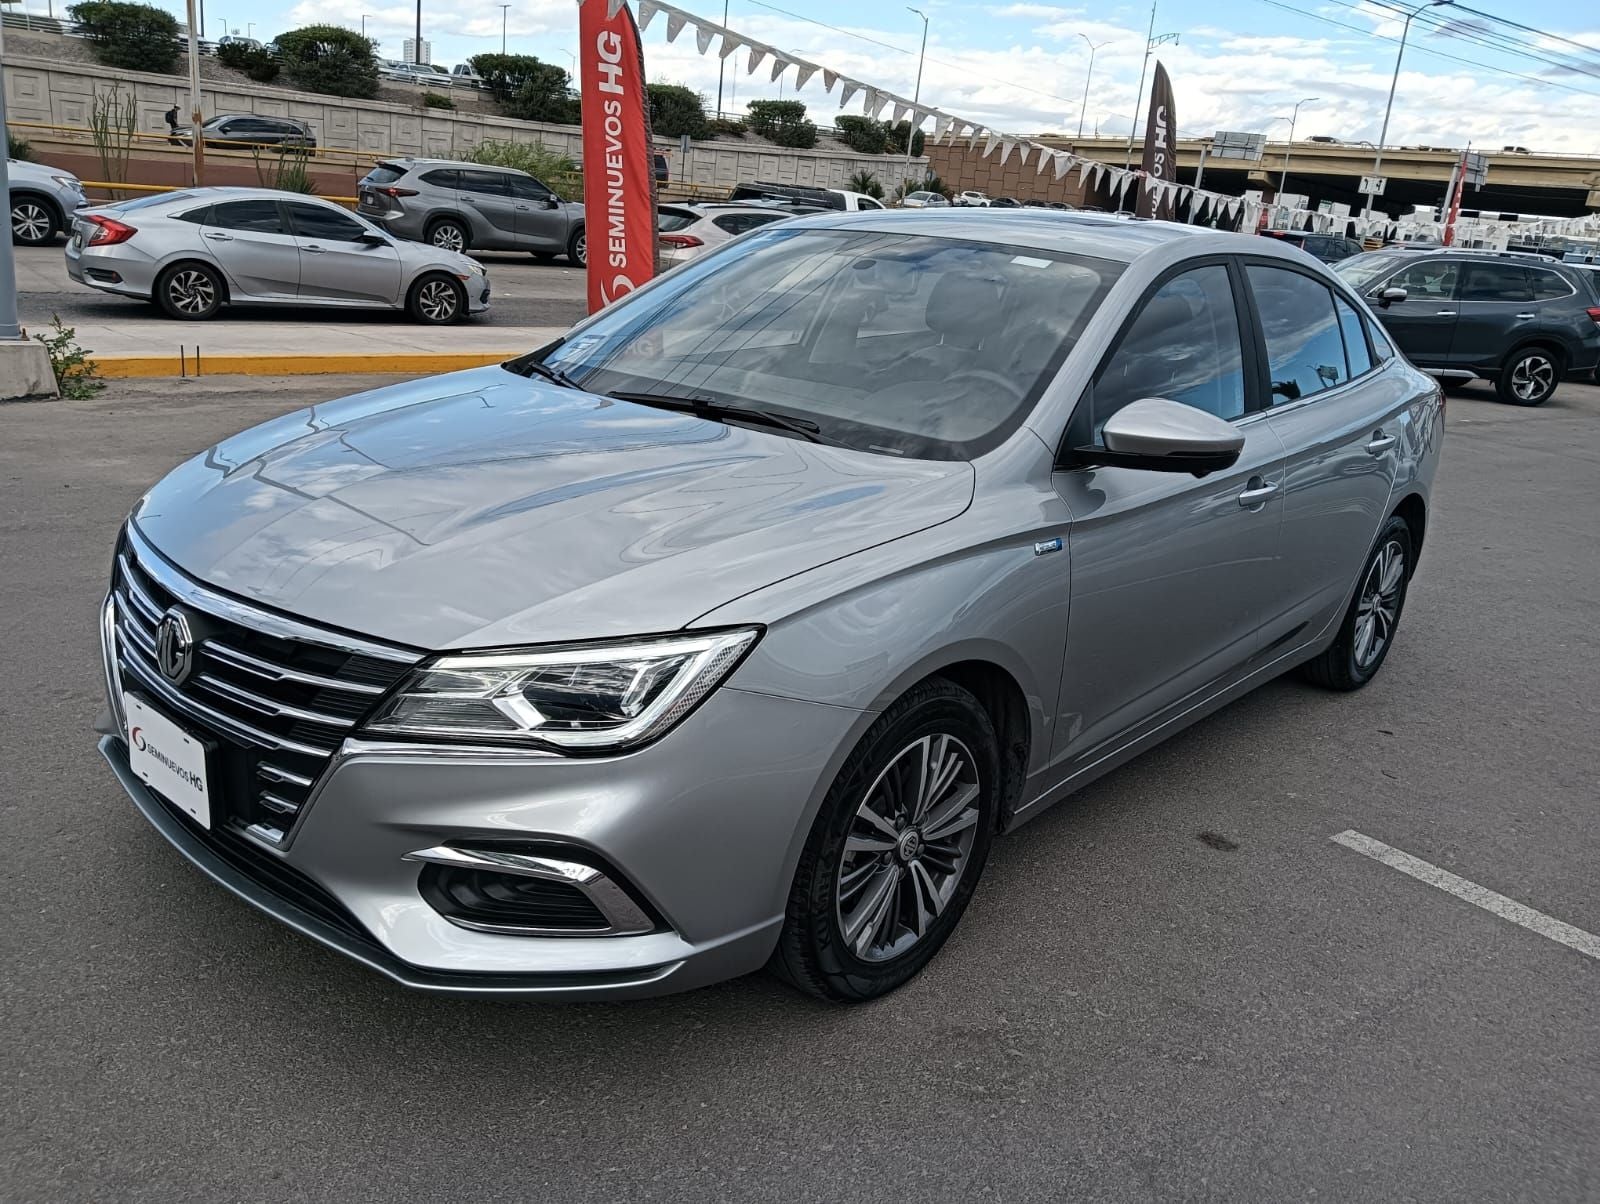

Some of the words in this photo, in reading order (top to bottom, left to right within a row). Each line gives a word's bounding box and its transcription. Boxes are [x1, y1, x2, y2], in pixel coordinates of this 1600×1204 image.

[597, 30, 624, 95] HG
[604, 100, 627, 268] SEMINUEVOS
[147, 744, 189, 782] SEMINUEVOS
[189, 771, 204, 792] HG
